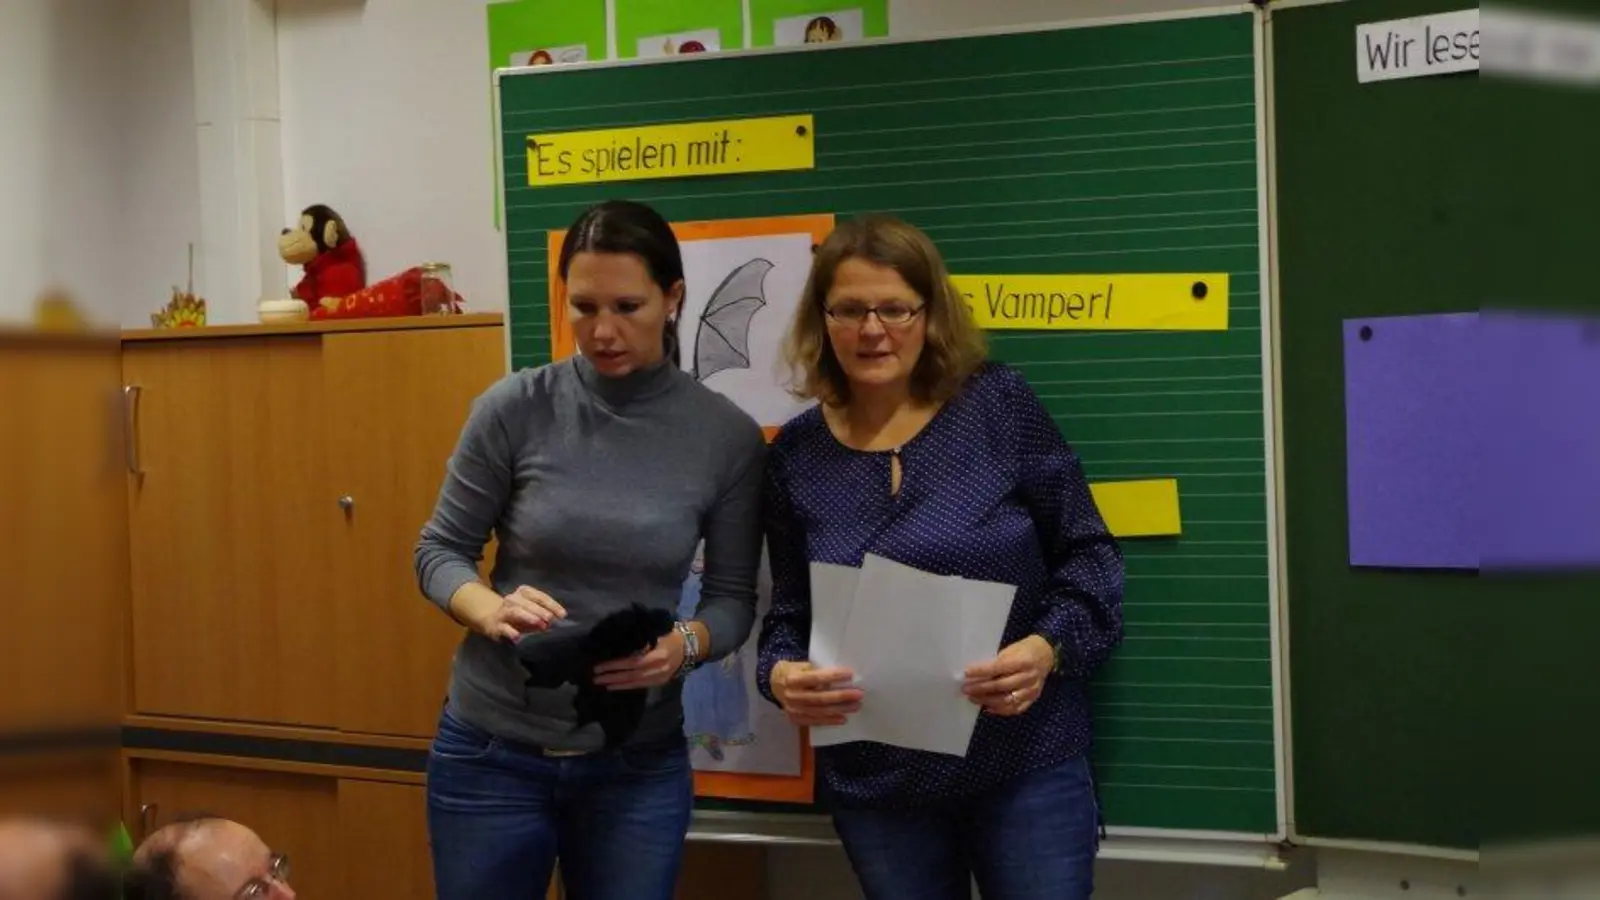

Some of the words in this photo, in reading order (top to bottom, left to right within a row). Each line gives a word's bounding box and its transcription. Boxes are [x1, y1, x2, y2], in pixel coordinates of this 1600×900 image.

[1365, 31, 1415, 70] Wir
[536, 142, 572, 177] Es
[580, 136, 677, 179] spielen
[984, 282, 1114, 324] Vamperl
